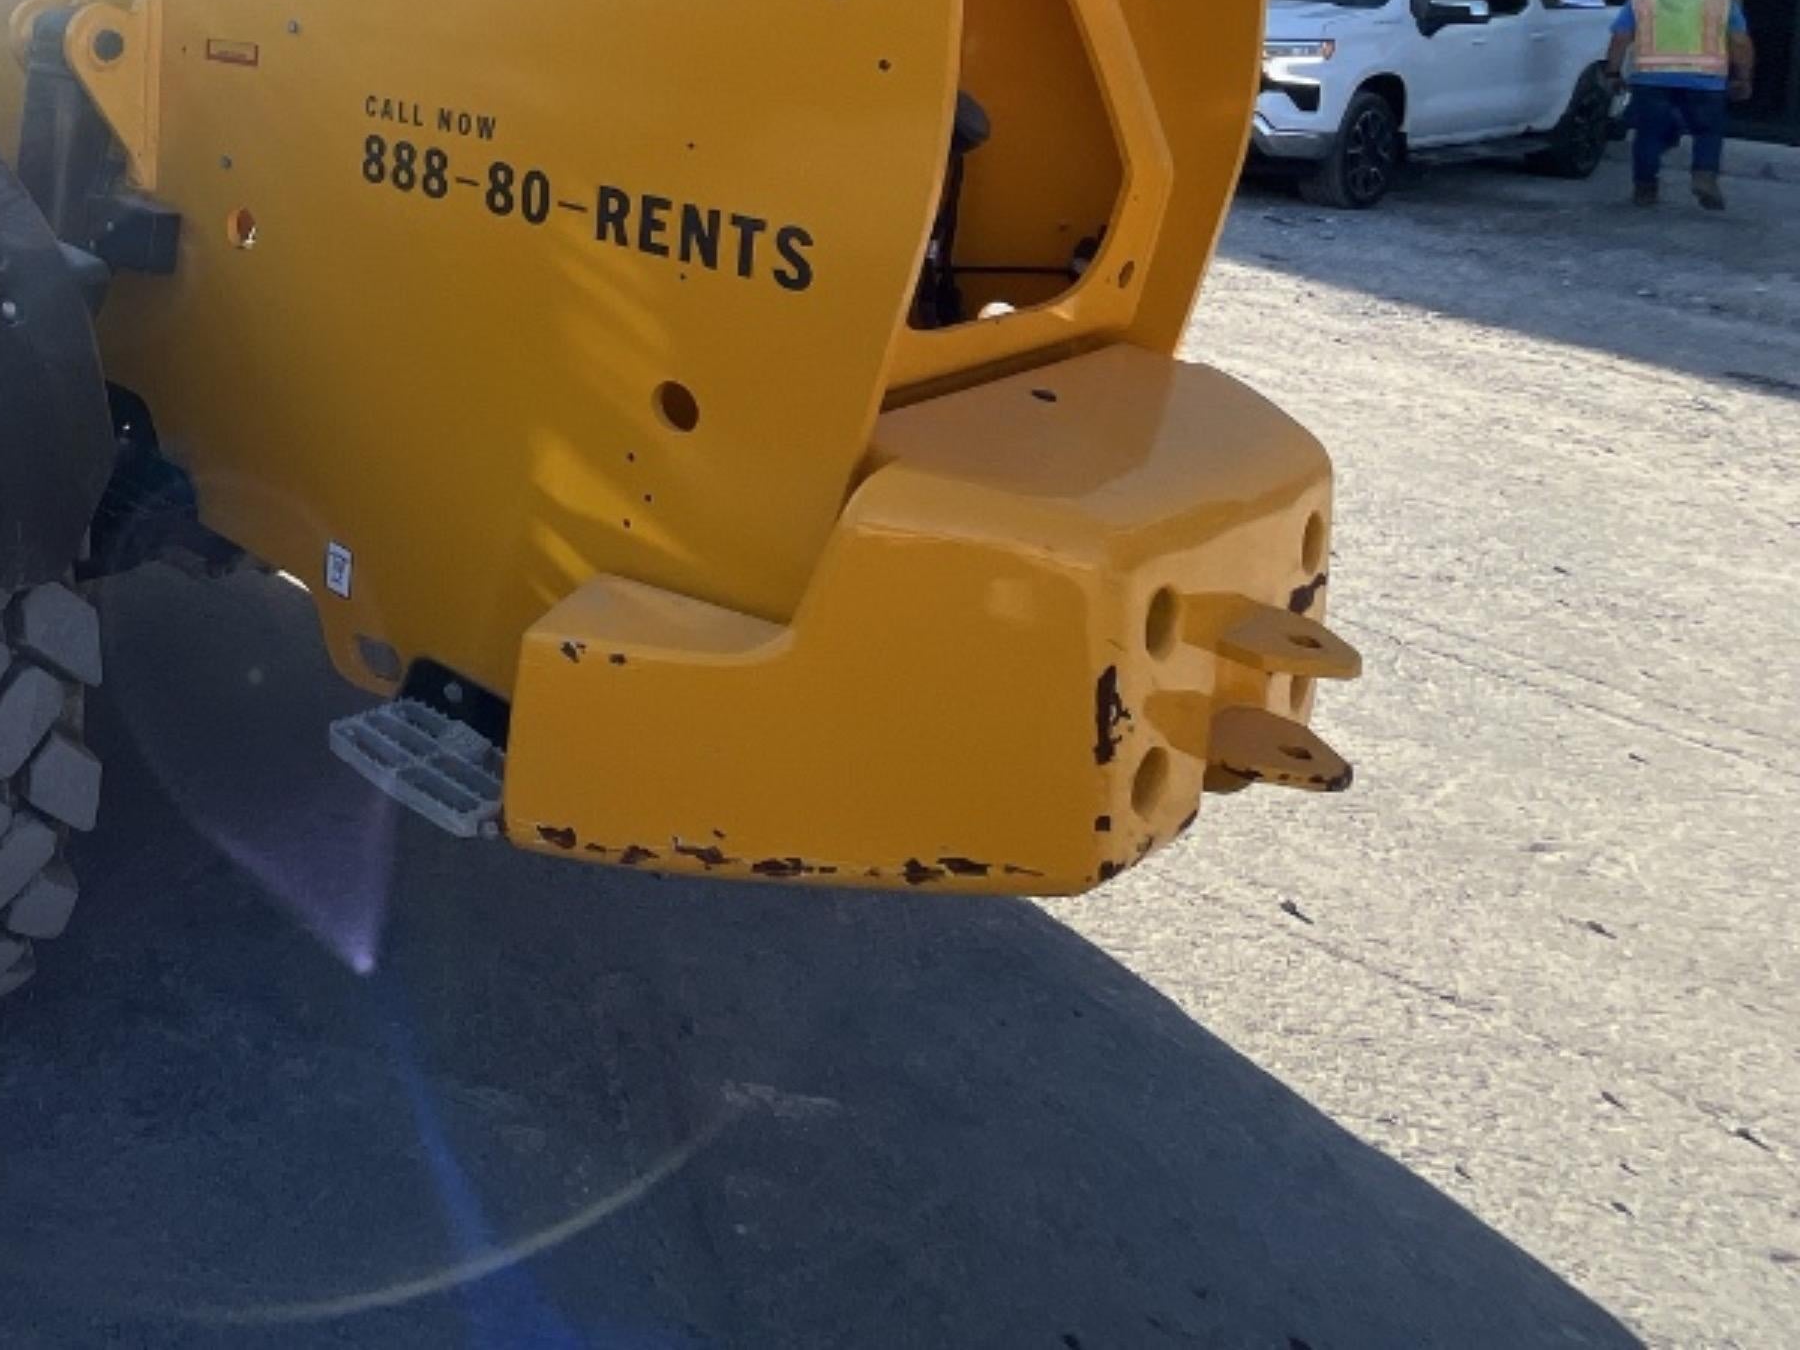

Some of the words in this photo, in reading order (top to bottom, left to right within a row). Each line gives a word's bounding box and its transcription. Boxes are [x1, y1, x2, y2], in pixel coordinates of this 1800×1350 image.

[364, 95, 424, 127] CALL
[437, 106, 497, 140] NOW
[362, 134, 814, 292] 888-80-RENTS
